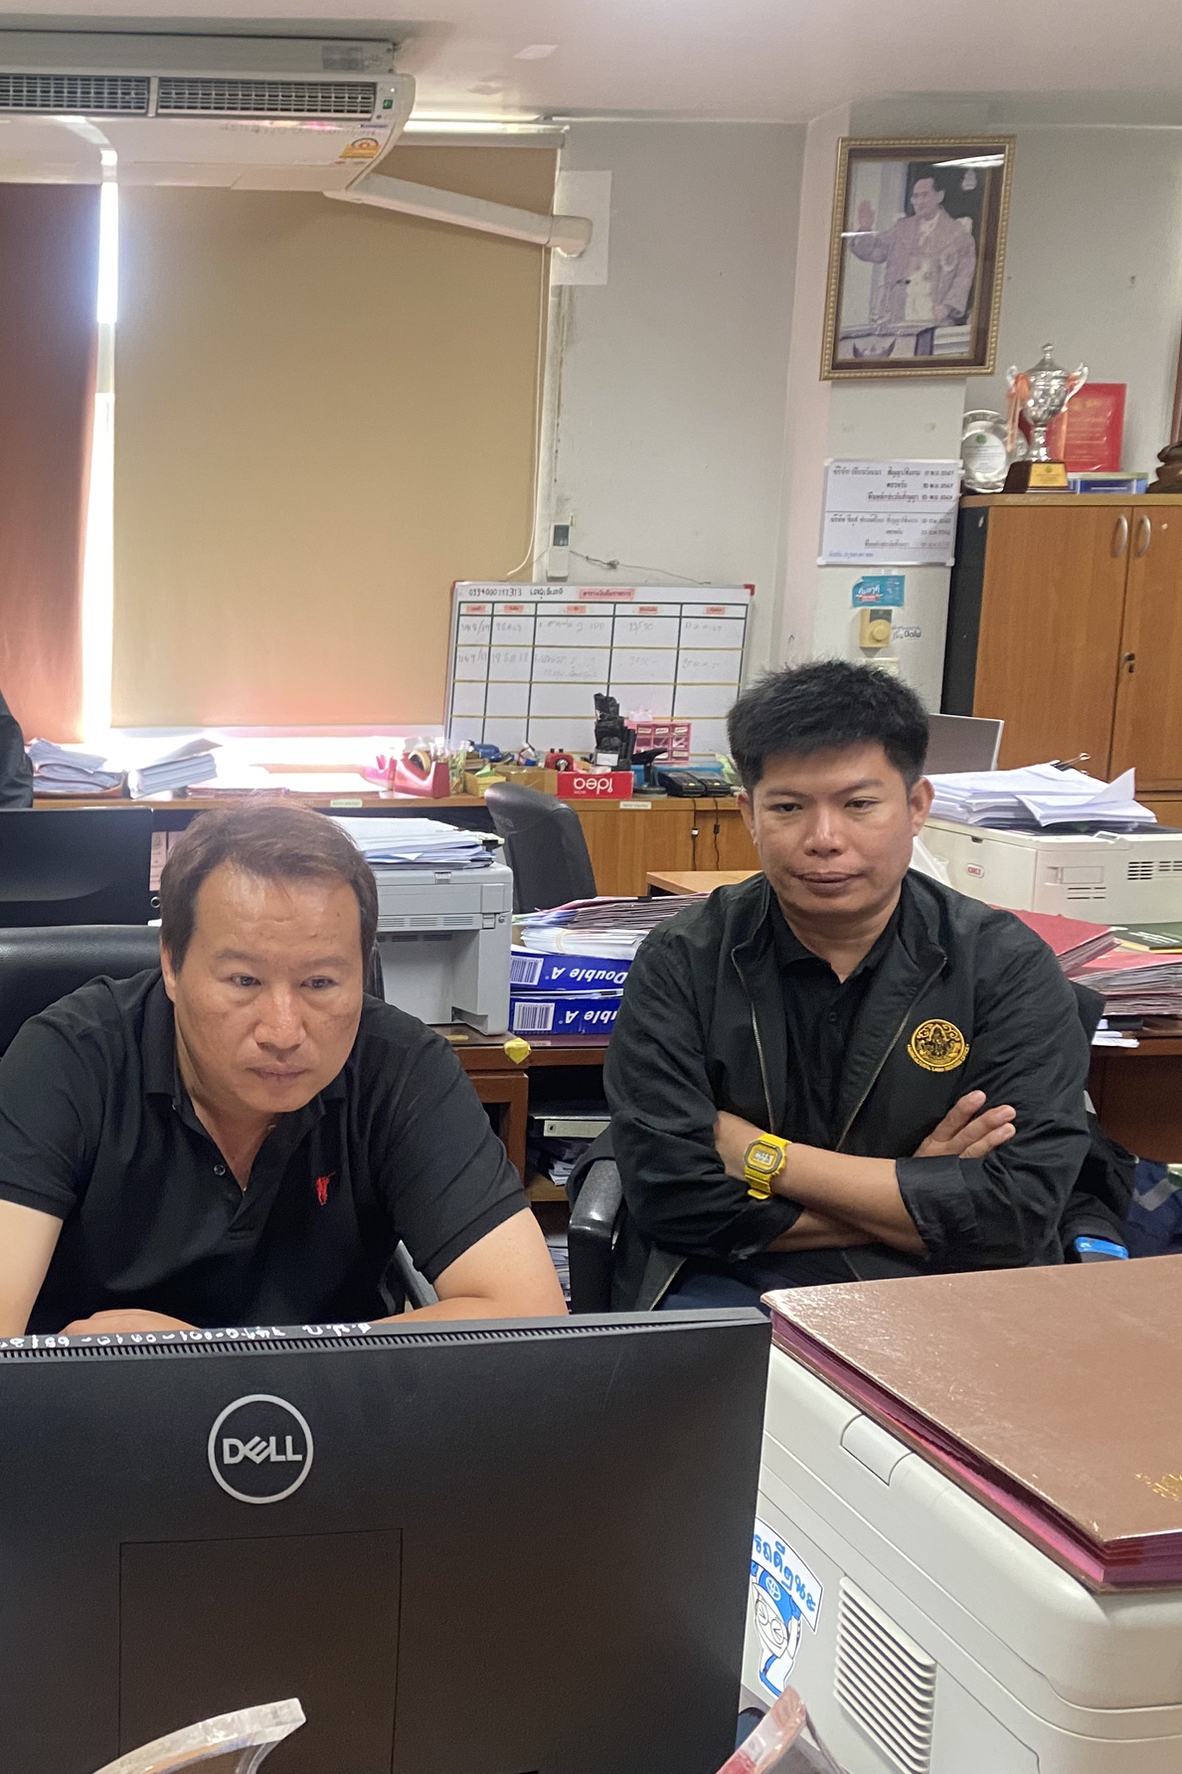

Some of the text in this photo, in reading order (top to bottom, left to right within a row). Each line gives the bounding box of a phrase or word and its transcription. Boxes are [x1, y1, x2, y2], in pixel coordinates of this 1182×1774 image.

[574, 778, 613, 794] idea
[569, 967, 629, 984] Double
[222, 1435, 303, 1465] DELL
